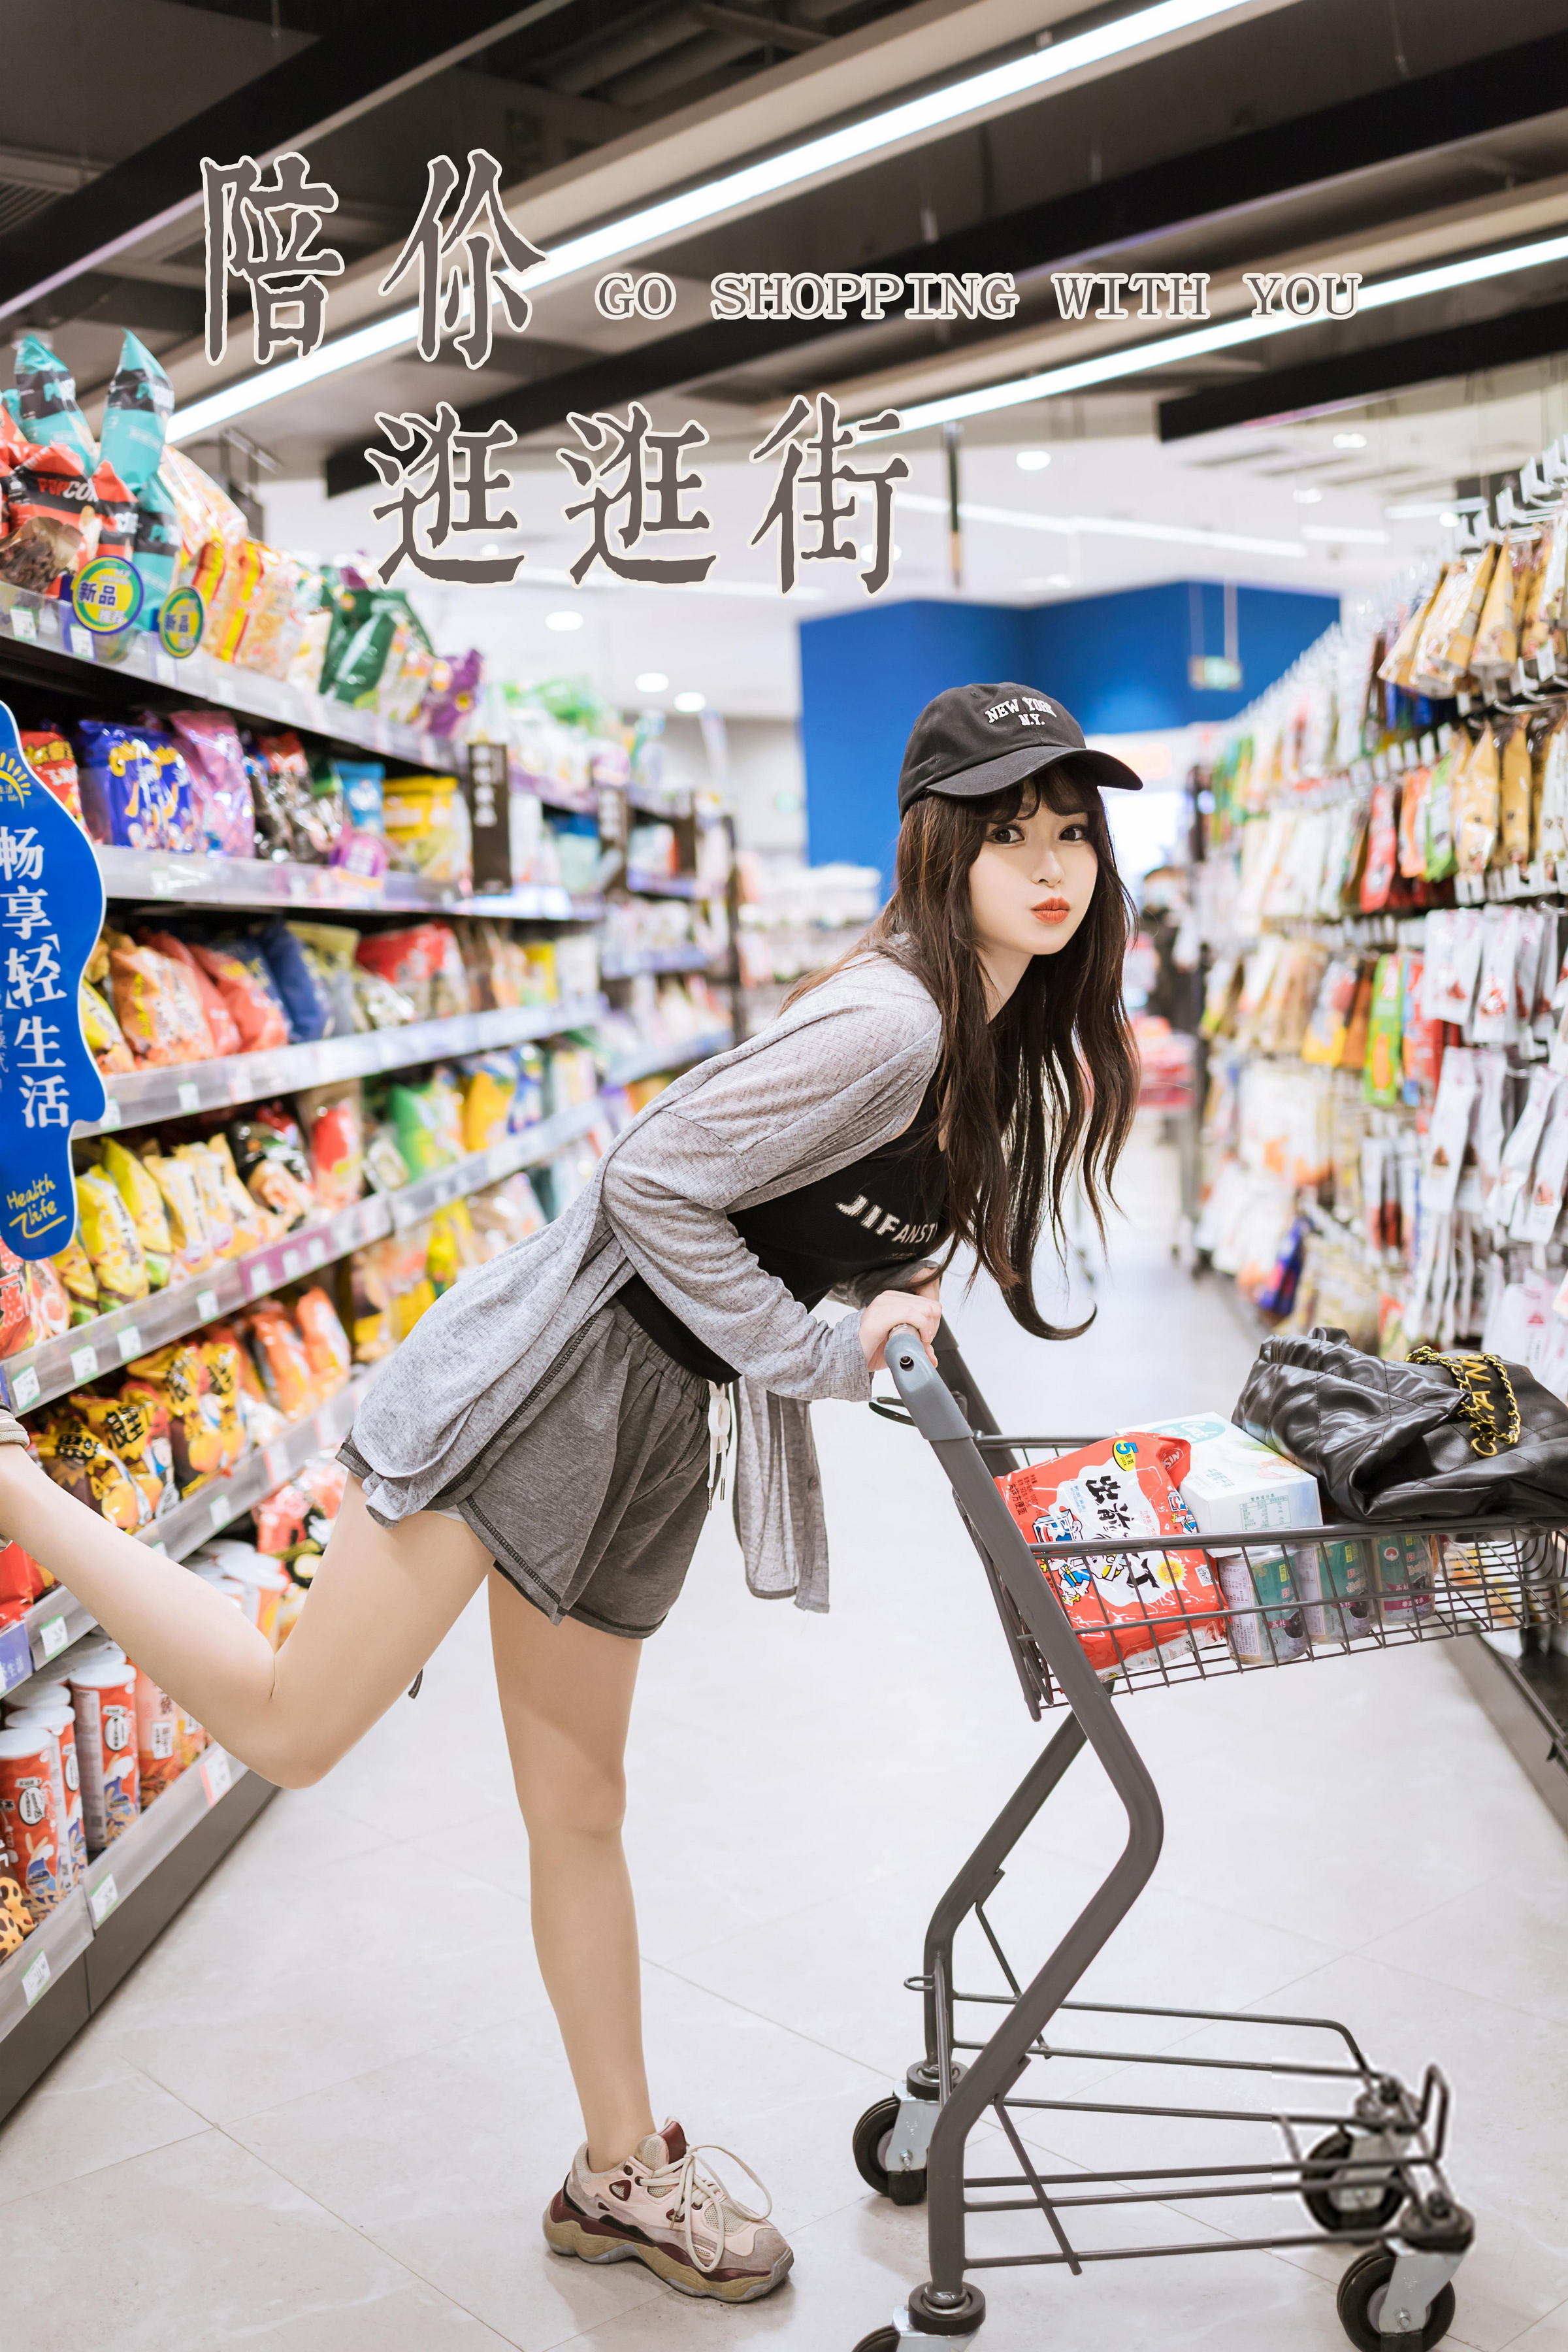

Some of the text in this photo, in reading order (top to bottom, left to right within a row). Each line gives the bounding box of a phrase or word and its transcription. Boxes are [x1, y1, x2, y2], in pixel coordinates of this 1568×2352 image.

[78, 582, 116, 606] 新品
[163, 613, 189, 632] 新品
[985, 698, 1019, 724] NEW
[1018, 713, 1045, 727] N.Y.
[6, 1173, 56, 1210] Health
[834, 1194, 939, 1243] JIFANST
[1116, 1441, 1138, 1455] 5
